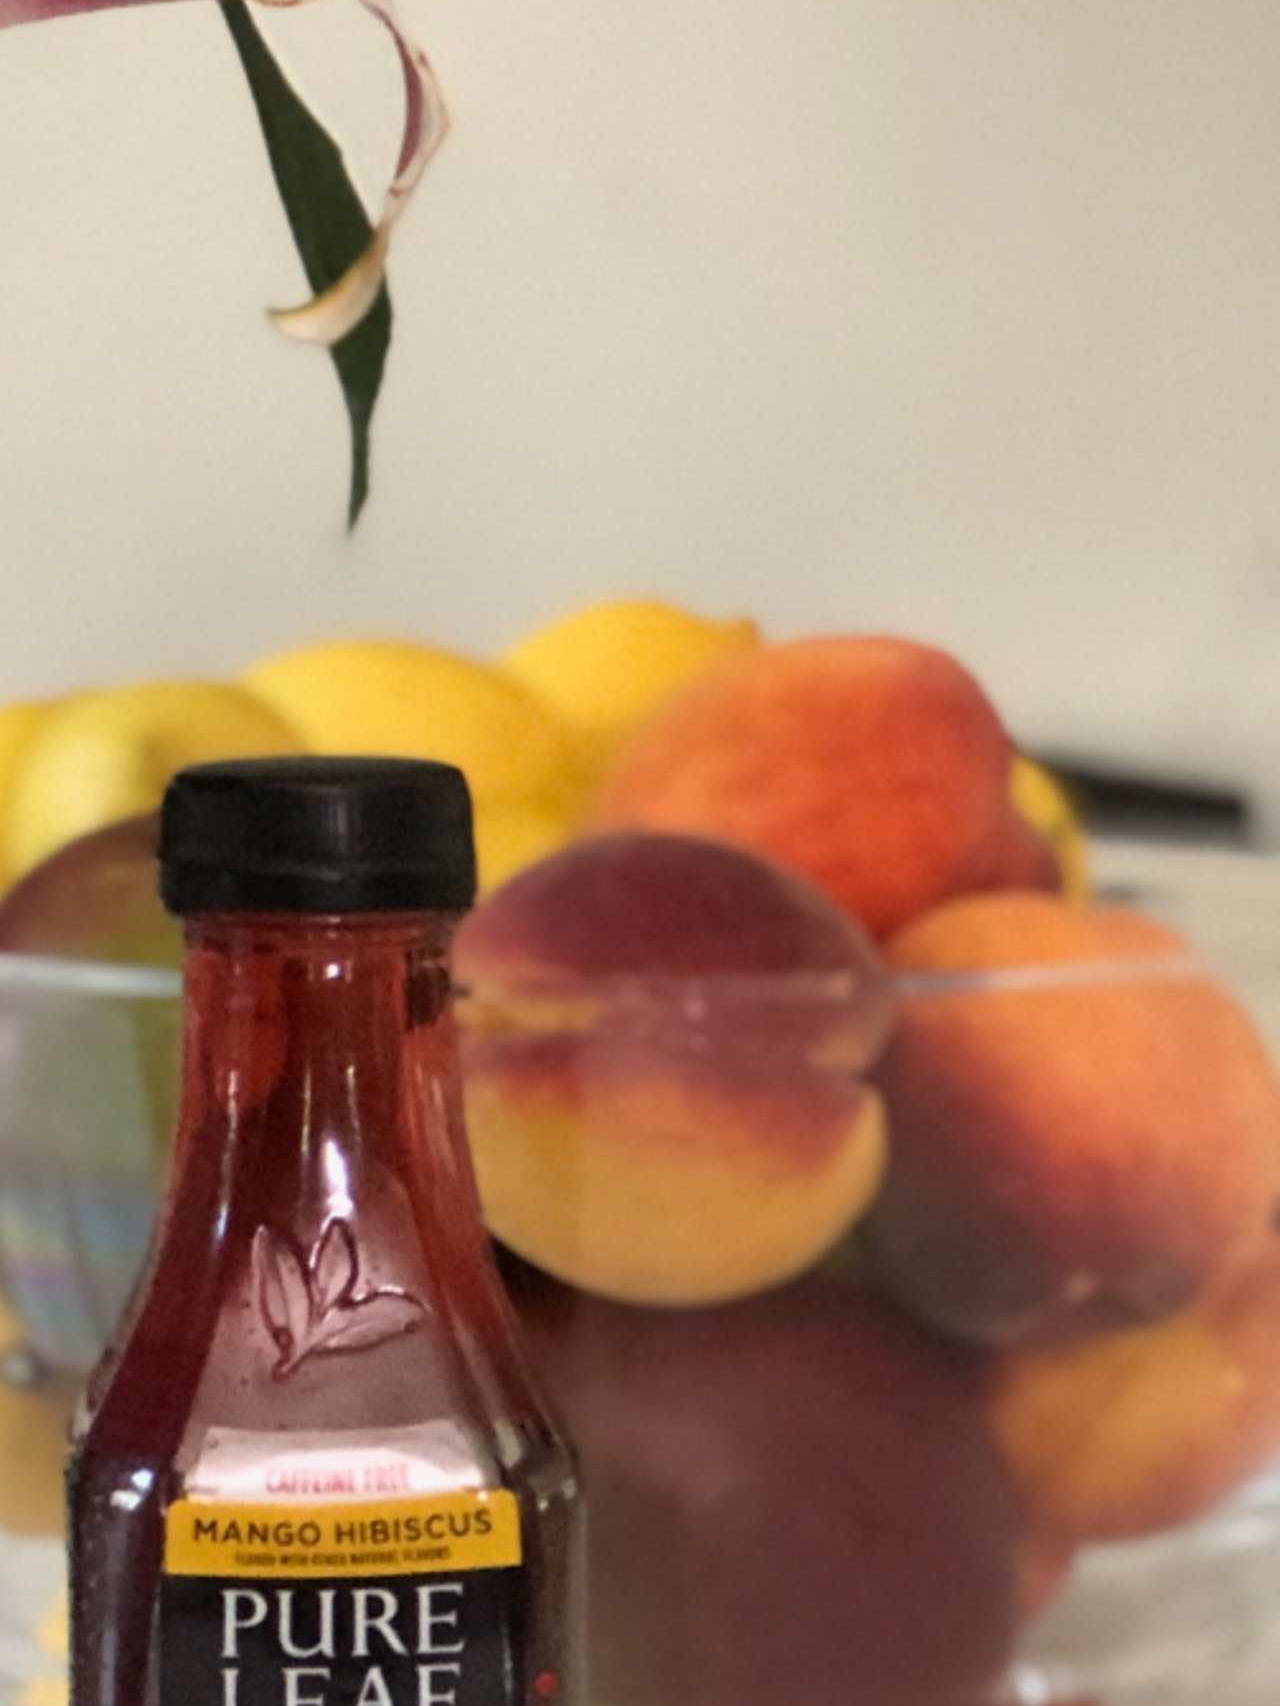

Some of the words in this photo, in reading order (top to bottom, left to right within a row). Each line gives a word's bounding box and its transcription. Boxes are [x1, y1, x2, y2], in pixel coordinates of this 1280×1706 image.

[192, 1517, 321, 1547] MANGO
[335, 1508, 492, 1545] HIBISCUS
[221, 1583, 465, 1659] PURE
